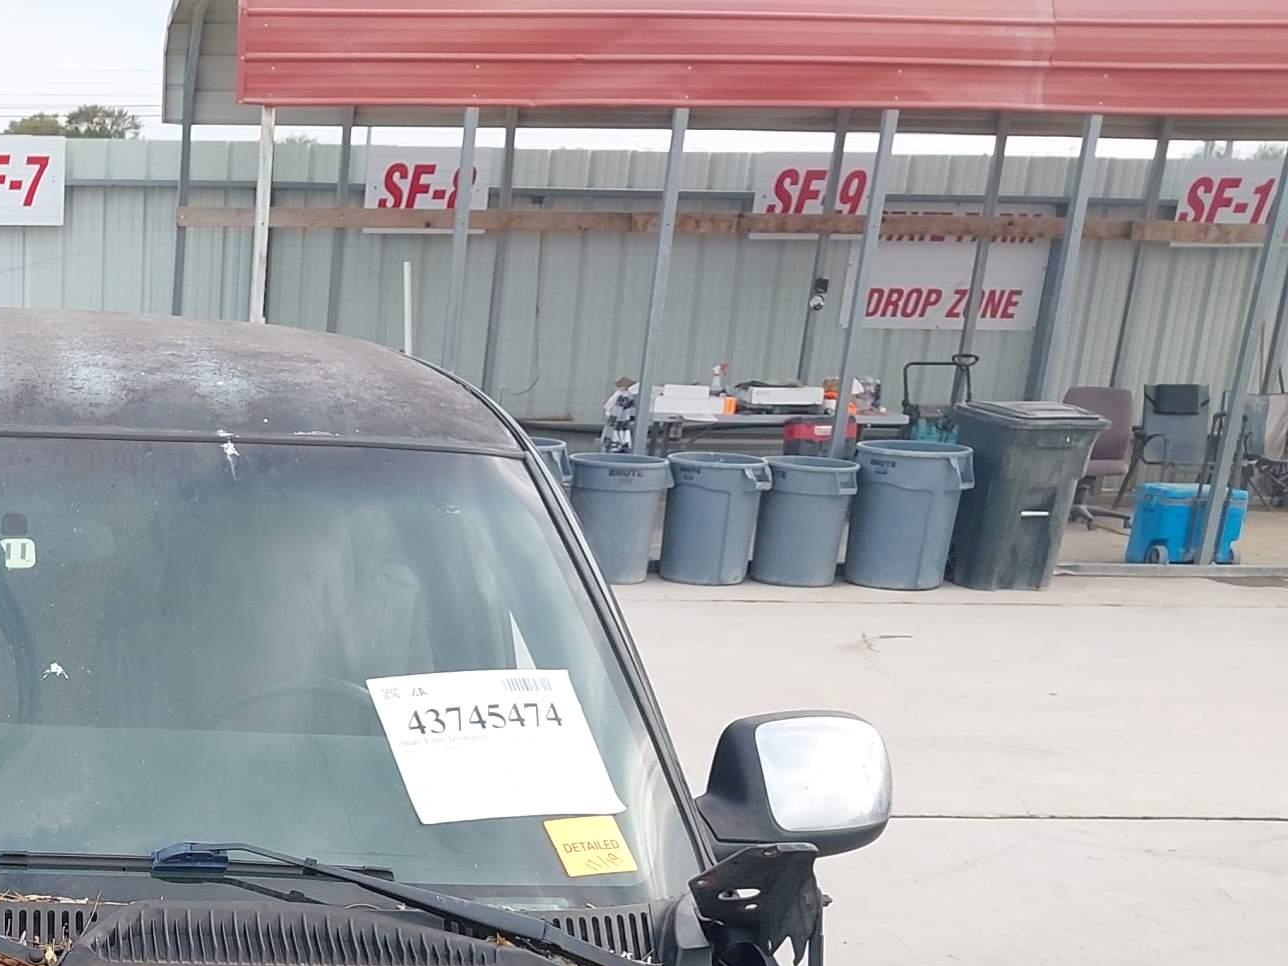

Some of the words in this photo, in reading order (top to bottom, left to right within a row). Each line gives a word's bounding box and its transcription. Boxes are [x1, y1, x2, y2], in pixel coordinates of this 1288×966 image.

[765, 168, 867, 214] SF9
[865, 287, 942, 318] DROP
[407, 703, 563, 735] 43745474
[562, 839, 620, 854] DETAILED
